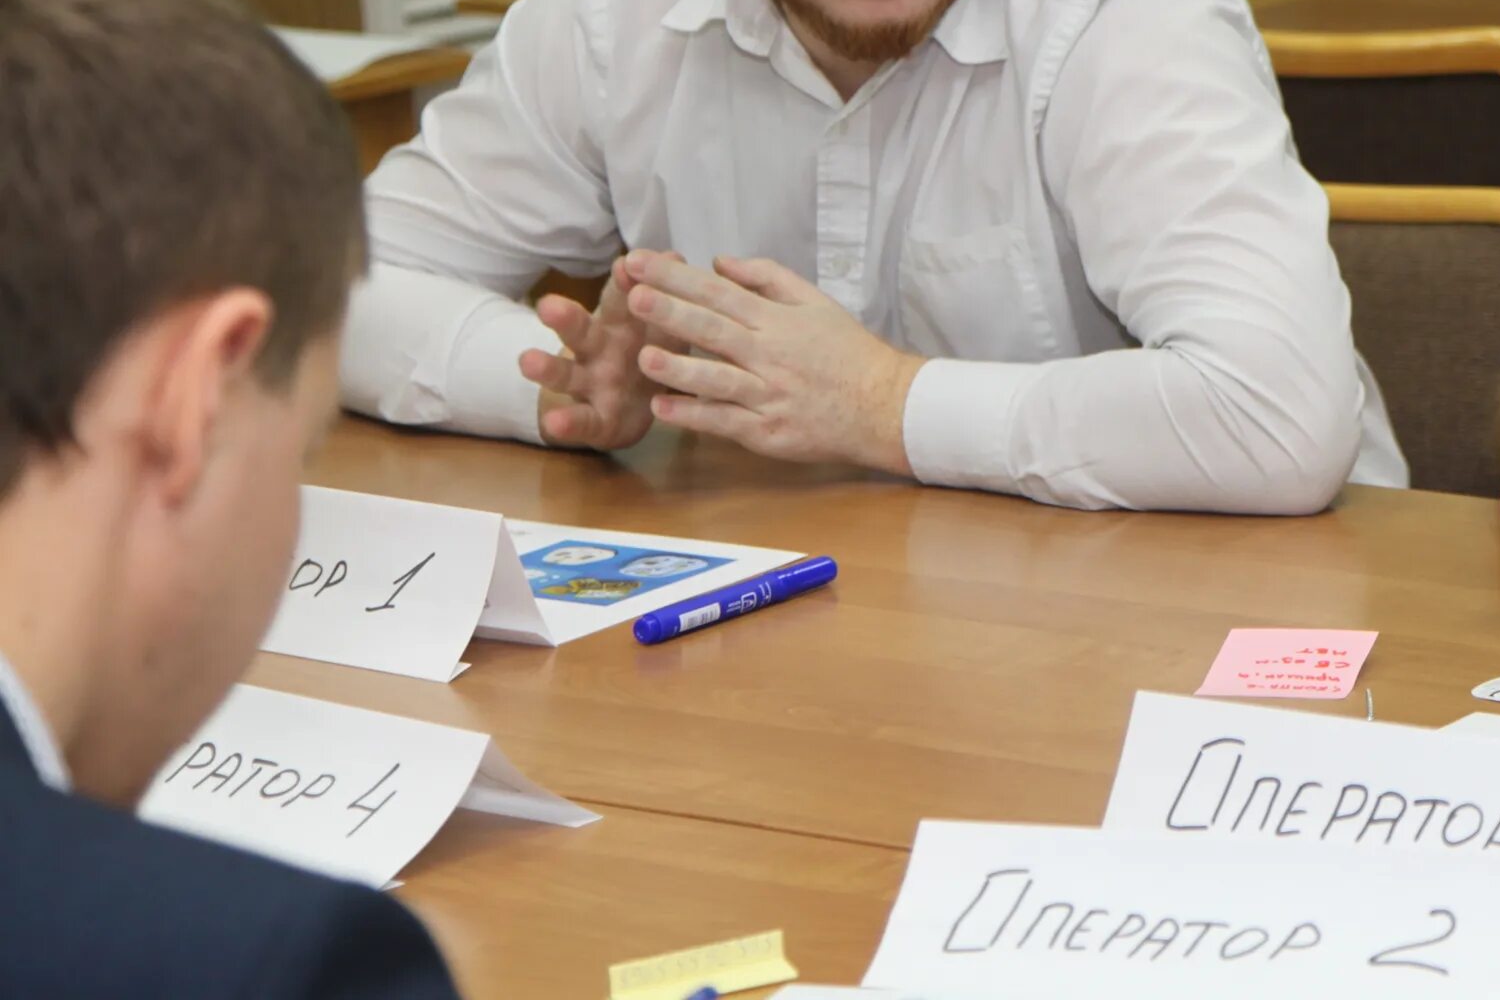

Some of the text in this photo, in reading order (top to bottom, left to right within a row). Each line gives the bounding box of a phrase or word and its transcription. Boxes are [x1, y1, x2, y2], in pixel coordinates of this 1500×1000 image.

[289, 552, 436, 612] ОР 1
[164, 741, 400, 838] РАТОР 4
[1367, 908, 1457, 976] 2
